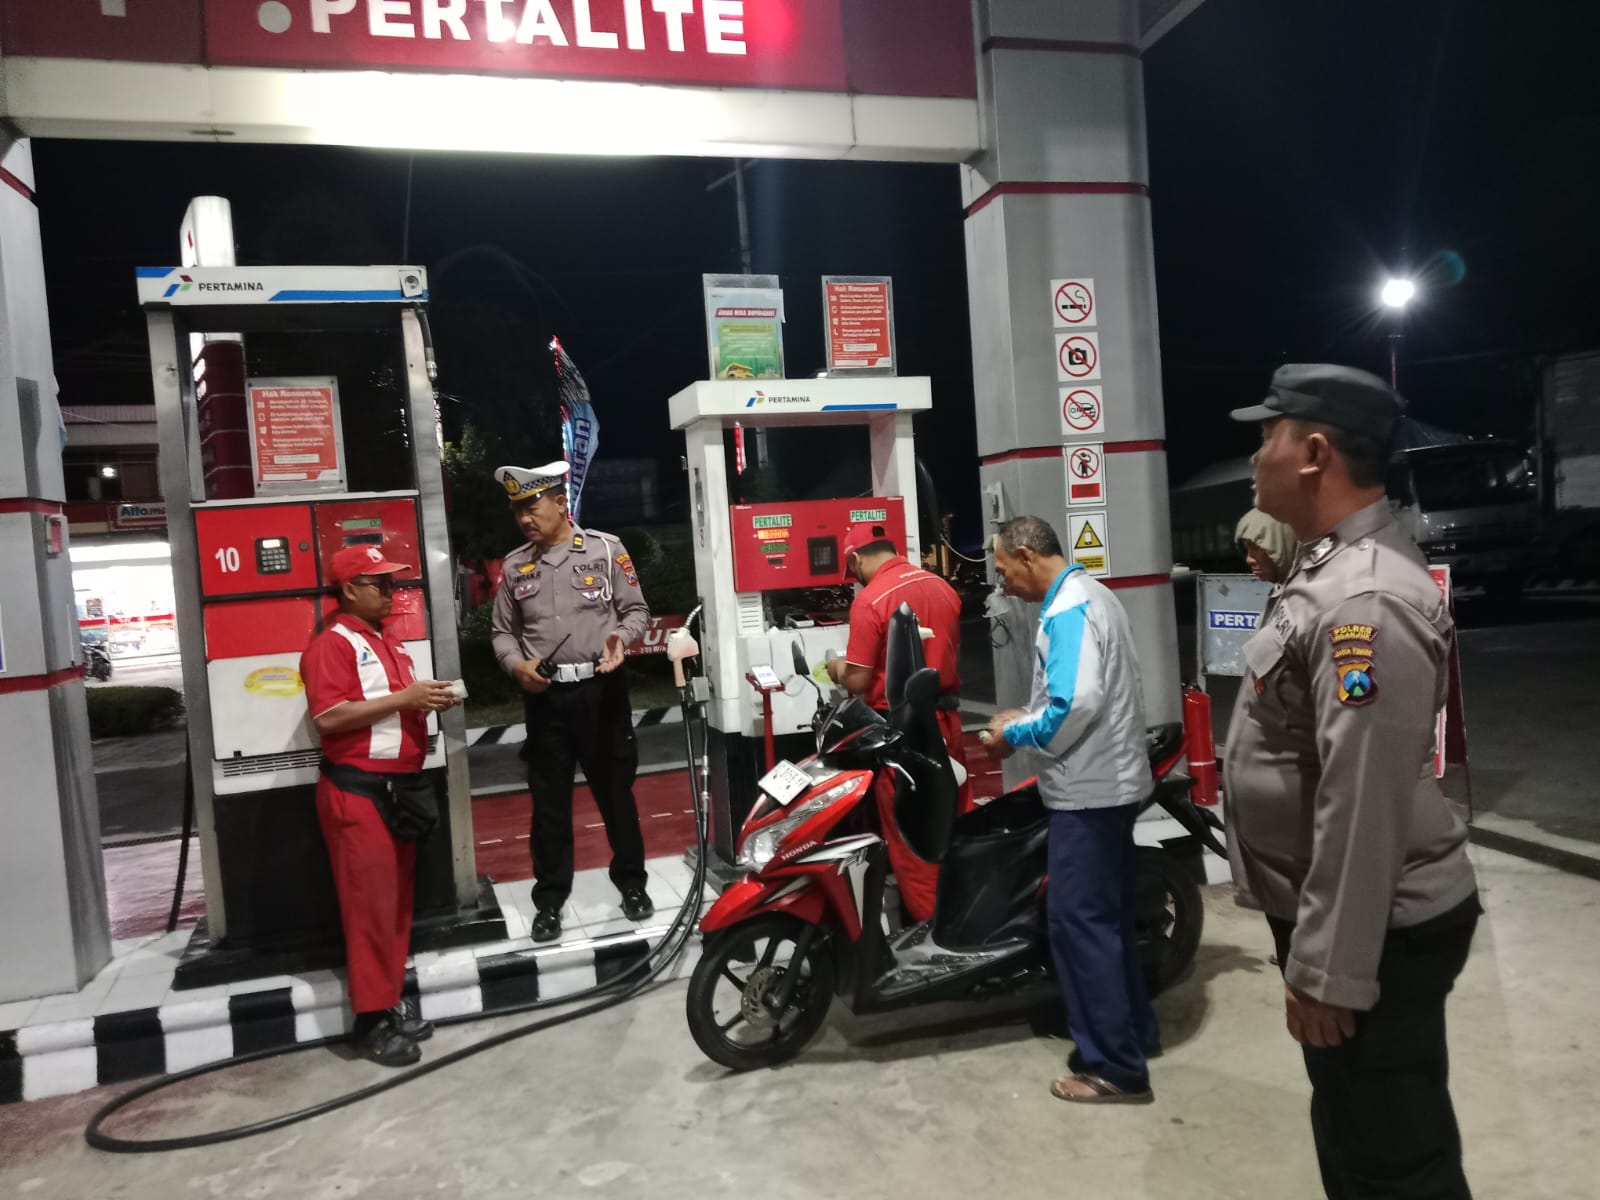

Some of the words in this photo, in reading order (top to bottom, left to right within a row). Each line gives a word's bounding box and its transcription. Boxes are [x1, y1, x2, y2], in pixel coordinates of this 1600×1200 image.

[311, 0, 747, 55] PERTALITE
[198, 282, 264, 291] PERTAMINA
[768, 396, 811, 404] PERTAMINA
[754, 515, 791, 528] PERTALITE
[851, 510, 886, 521] PERTALITE
[215, 547, 240, 573] 10
[1334, 625, 1373, 636] POLRES
[781, 840, 818, 861] HONDA
